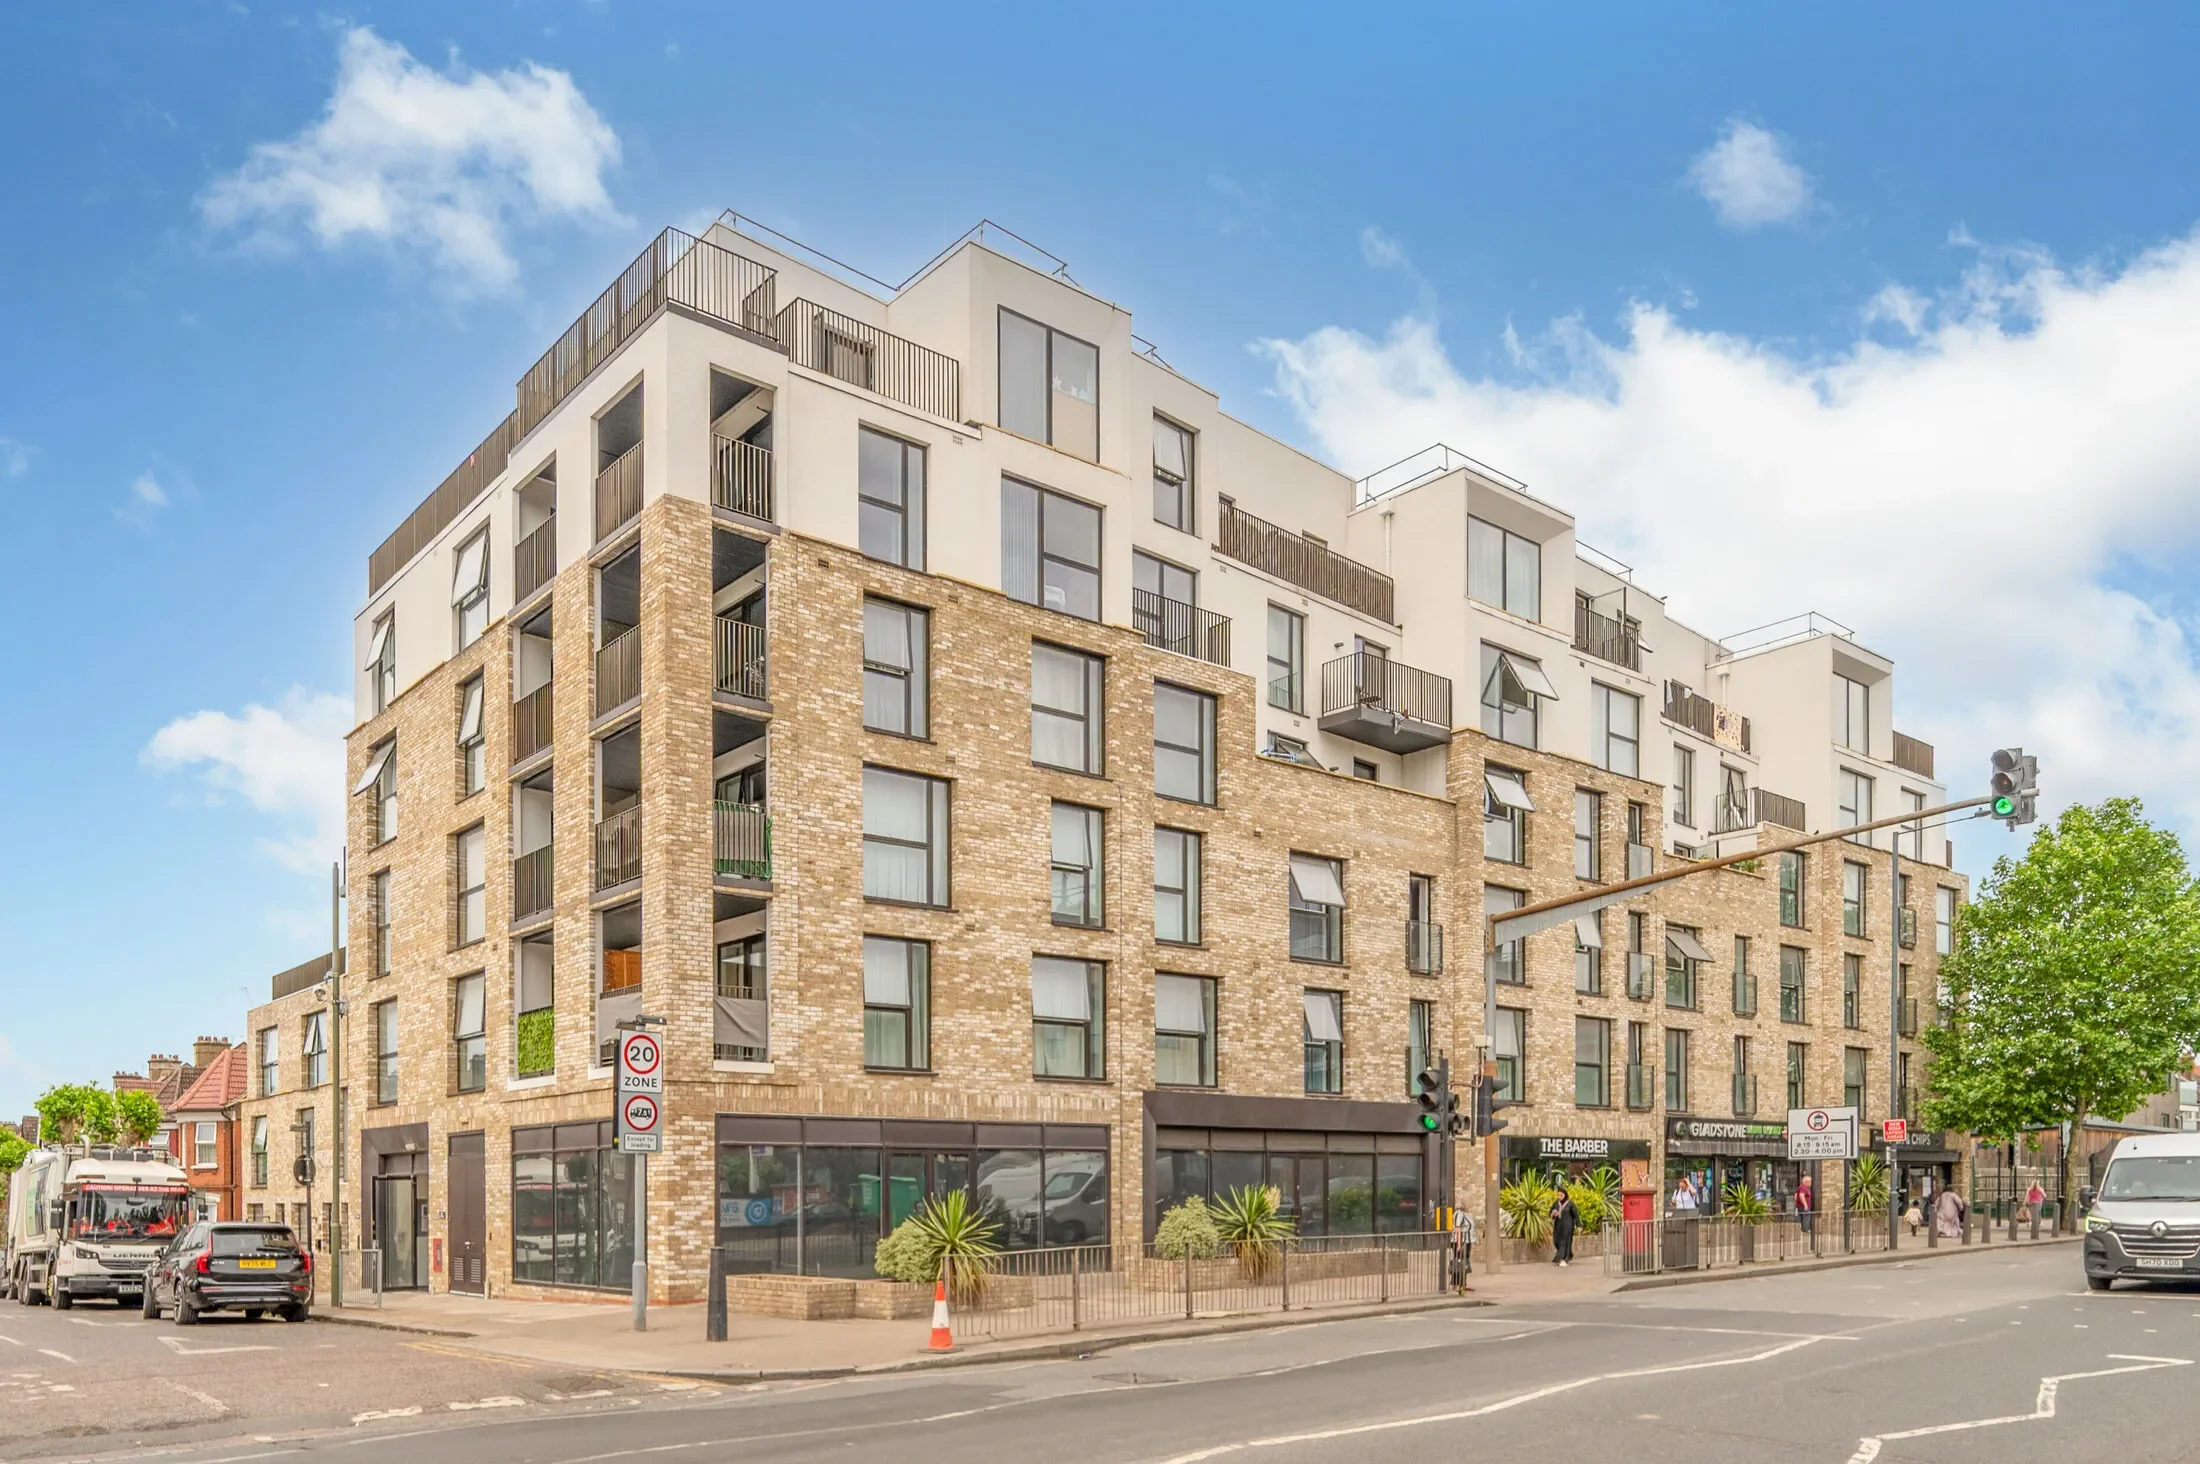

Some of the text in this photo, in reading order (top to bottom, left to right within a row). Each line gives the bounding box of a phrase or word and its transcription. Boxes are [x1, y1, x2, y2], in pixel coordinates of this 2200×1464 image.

[630, 1046, 654, 1062] 20
[624, 1076, 657, 1088] ZONE
[1690, 1122, 1747, 1138] GLADSTONE
[1540, 1138, 1608, 1153] THE BARBER
[1911, 1133, 1931, 1146] CHIPS
[113, 1184, 149, 1192] OPERATVES
